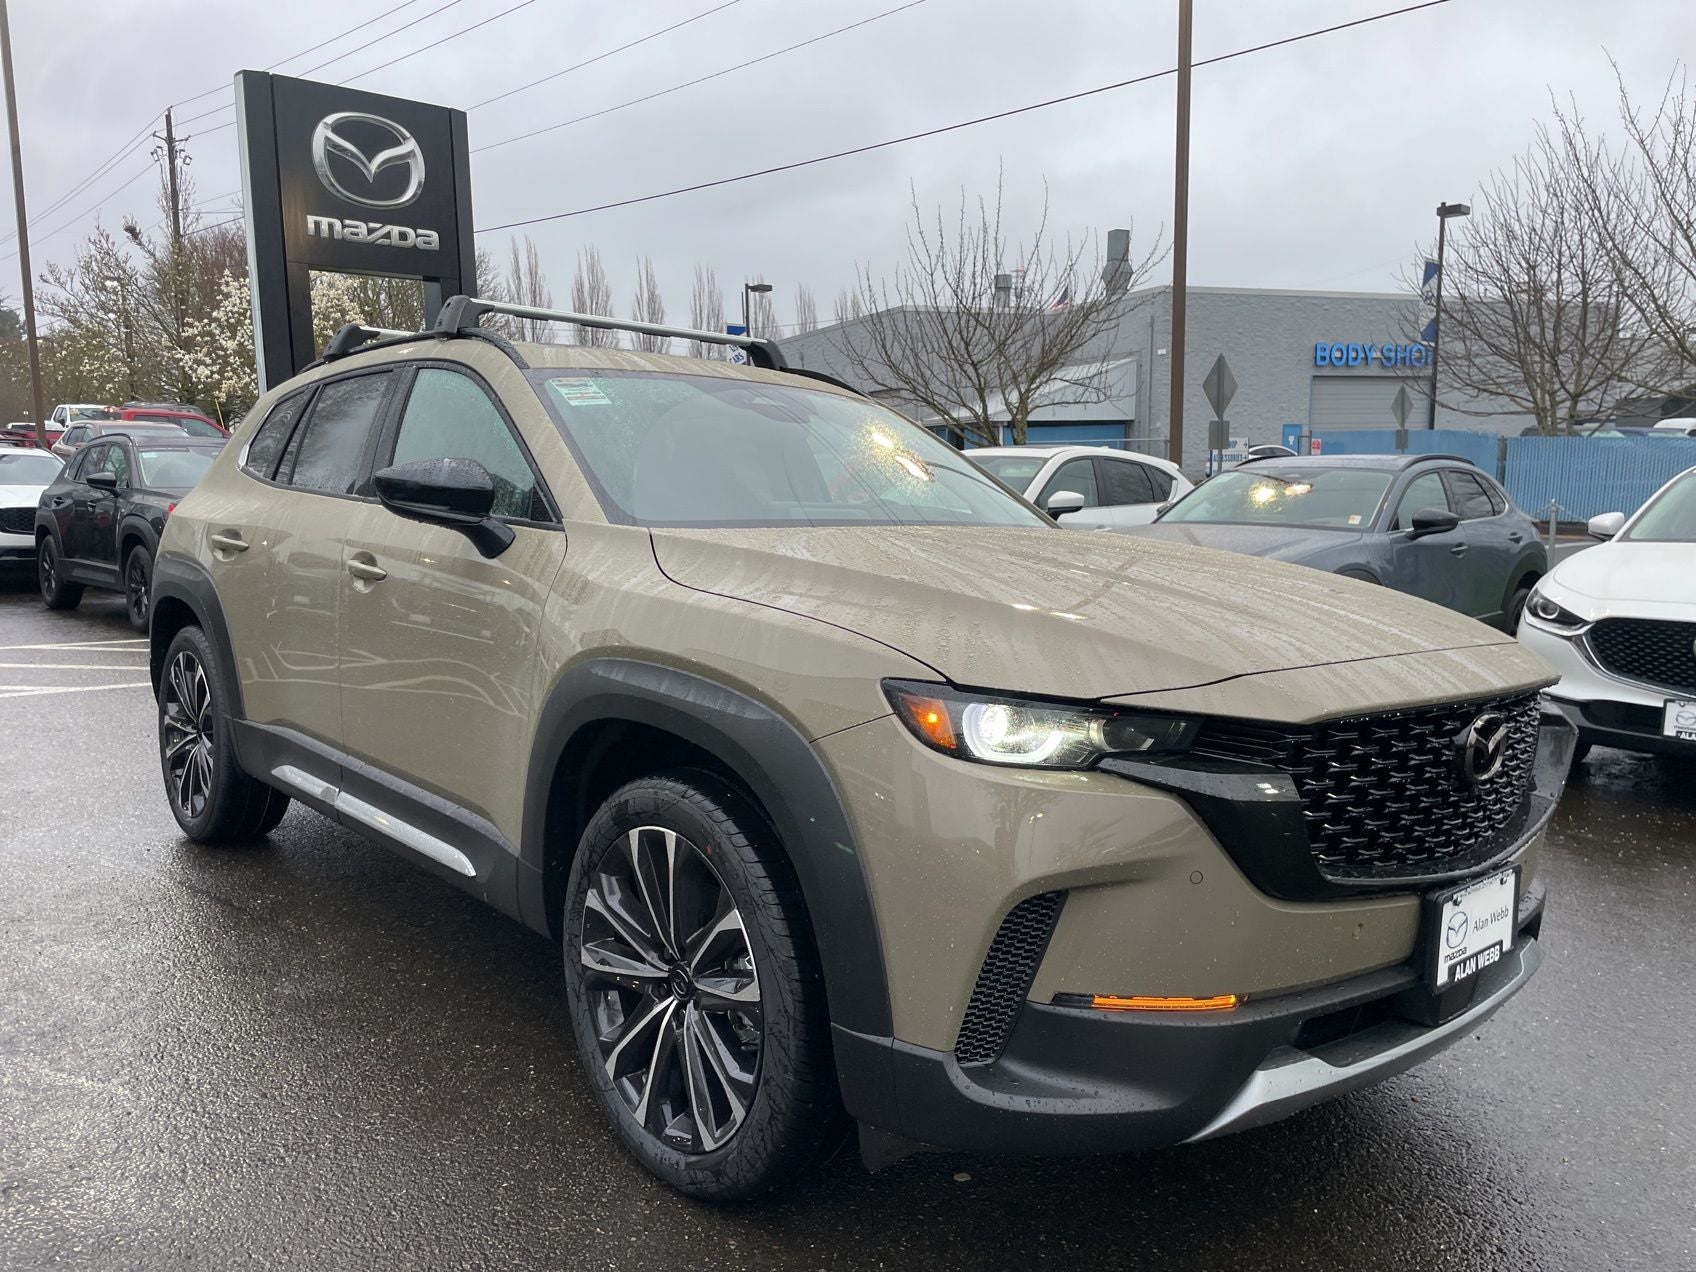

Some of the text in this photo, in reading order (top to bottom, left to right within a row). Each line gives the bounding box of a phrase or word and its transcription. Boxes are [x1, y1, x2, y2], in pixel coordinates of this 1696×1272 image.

[306, 214, 440, 251] mazda
[1315, 342, 1376, 368] BODY
[1472, 906, 1509, 933] Alan Webb
[1444, 946, 1467, 964] mazda
[1454, 944, 1500, 982] ALAN WEBB
